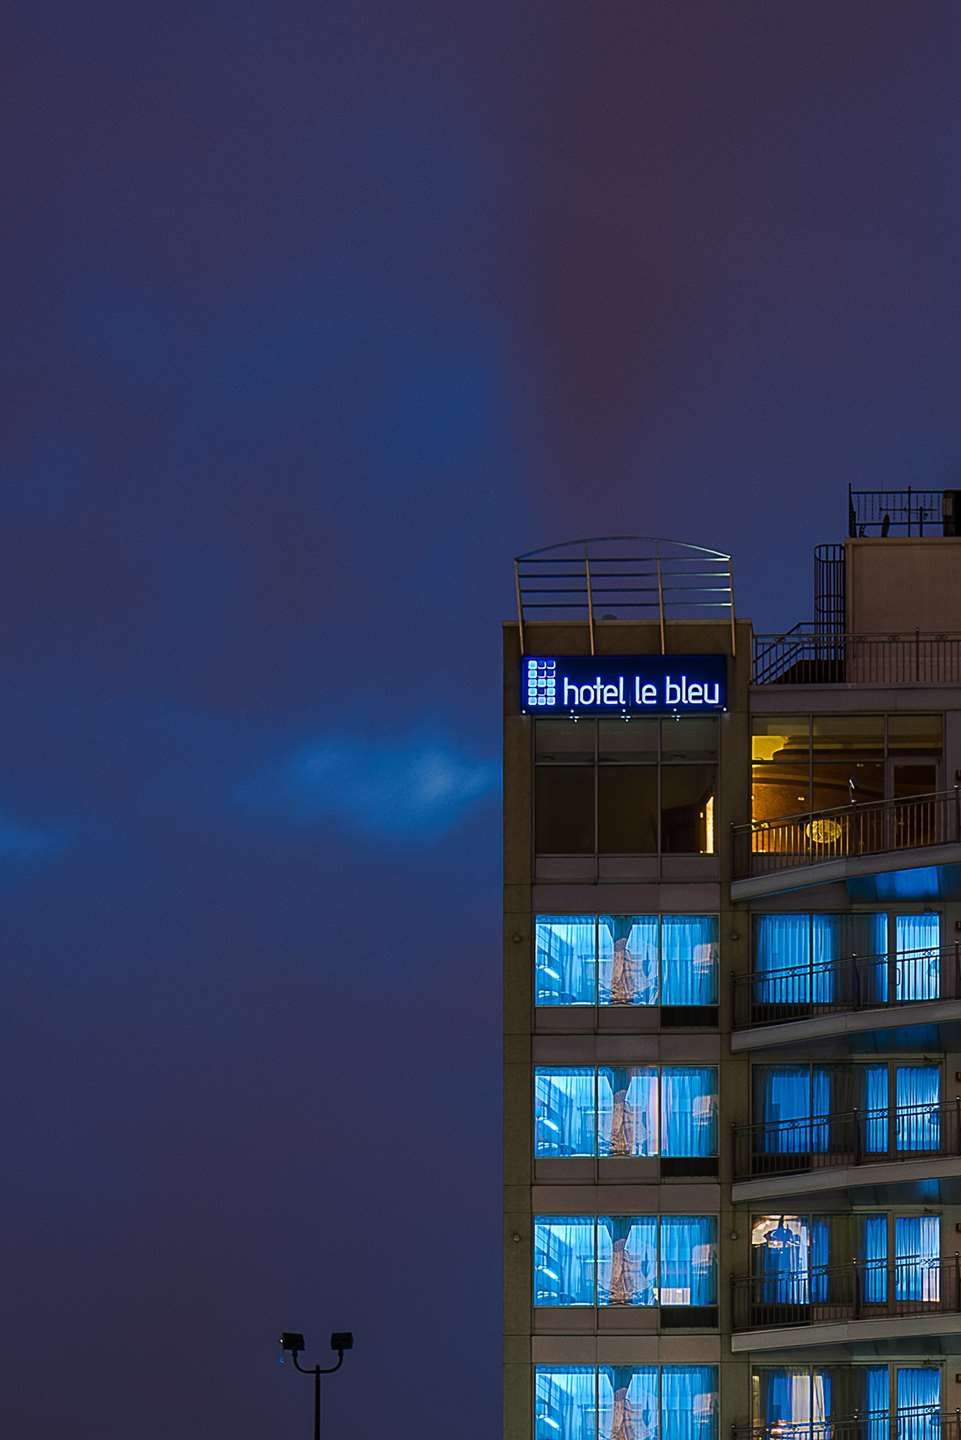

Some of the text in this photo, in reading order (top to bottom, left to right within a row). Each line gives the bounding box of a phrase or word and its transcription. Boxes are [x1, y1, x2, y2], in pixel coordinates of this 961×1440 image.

[563, 675, 720, 705] hotel le bleu
